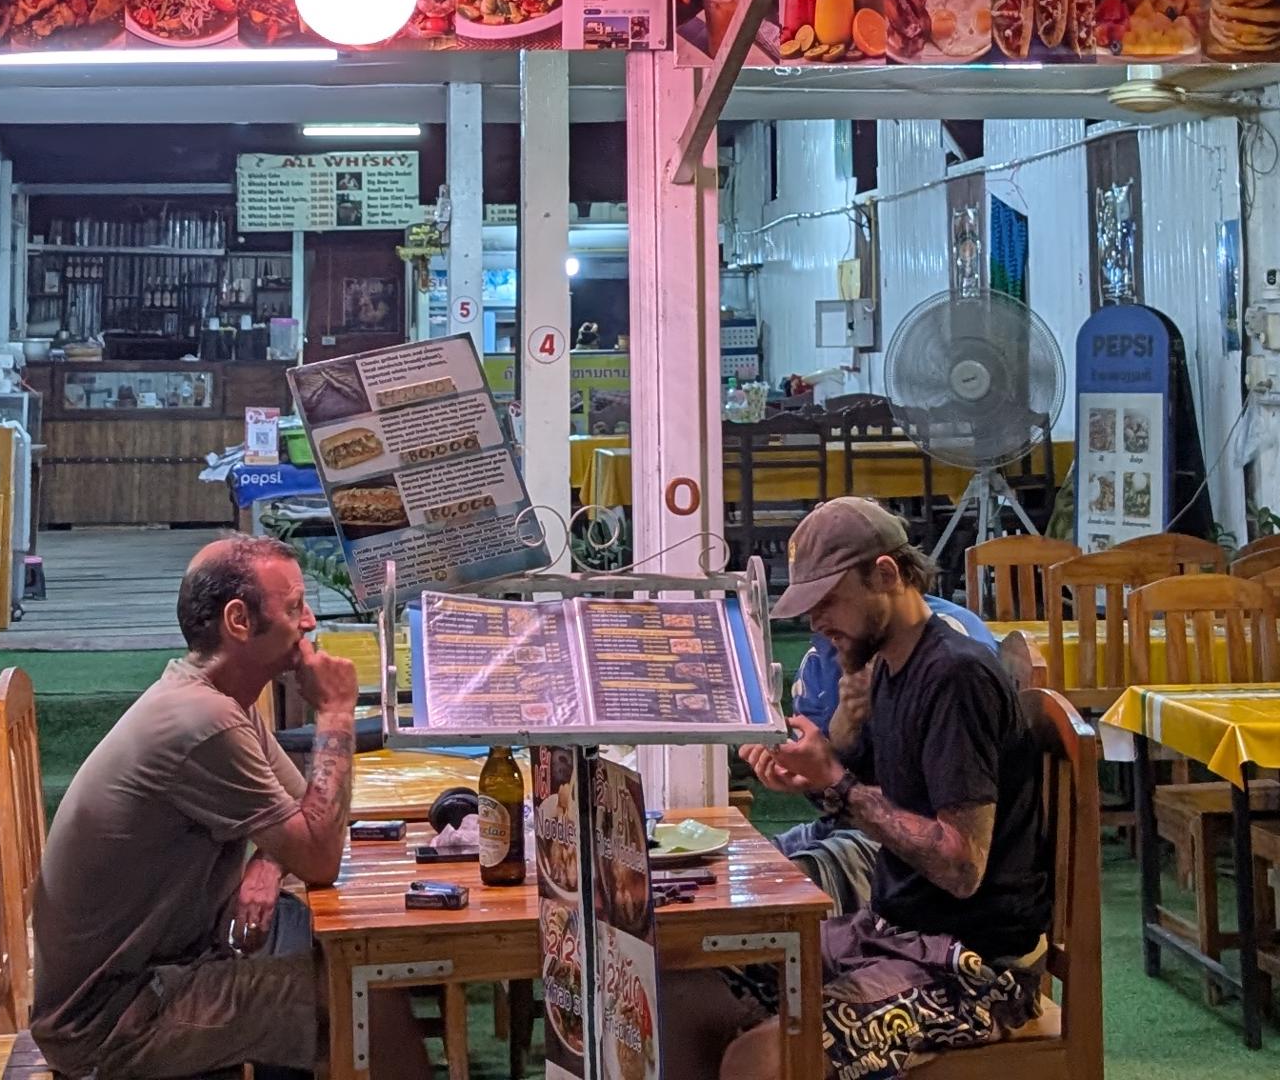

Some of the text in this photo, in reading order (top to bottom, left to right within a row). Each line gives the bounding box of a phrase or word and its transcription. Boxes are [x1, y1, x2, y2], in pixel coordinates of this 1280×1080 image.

[281, 157, 316, 169] ALL
[460, 302, 470, 318] 5
[539, 334, 555, 356] 4
[1092, 334, 1154, 358] PEPSI
[241, 471, 283, 486] pepsi
